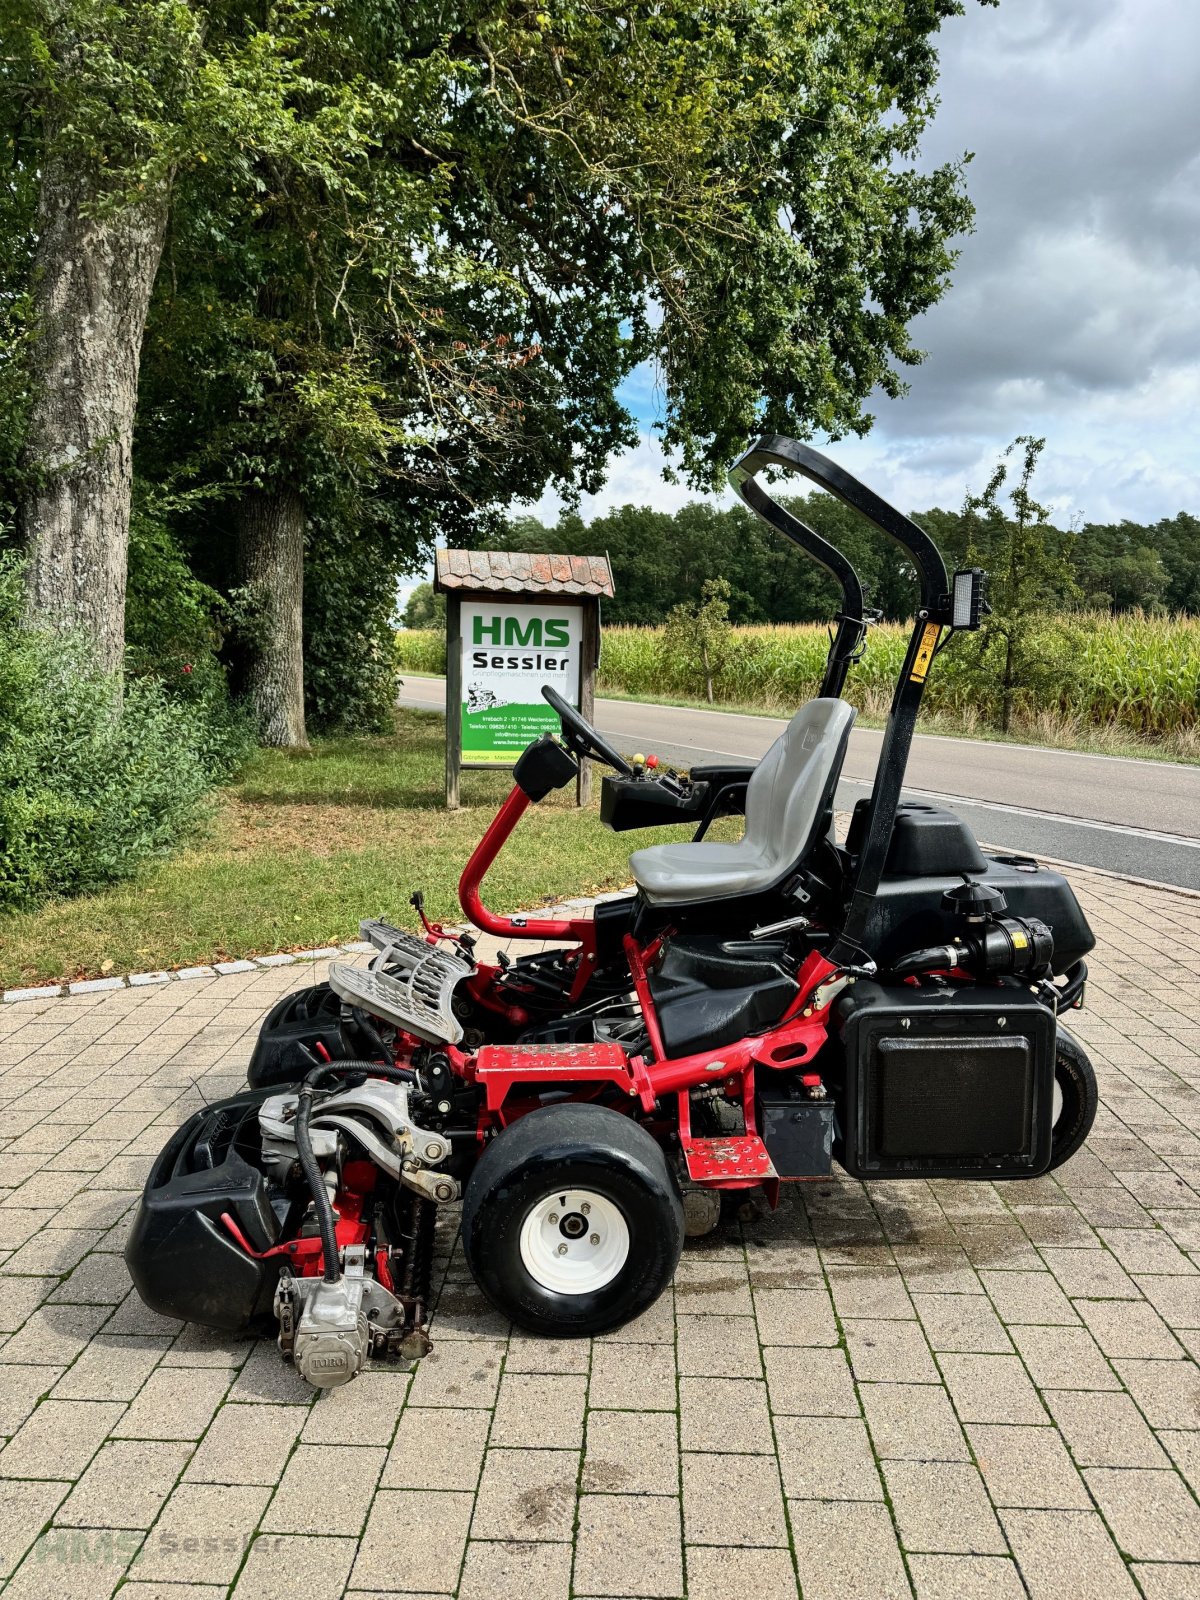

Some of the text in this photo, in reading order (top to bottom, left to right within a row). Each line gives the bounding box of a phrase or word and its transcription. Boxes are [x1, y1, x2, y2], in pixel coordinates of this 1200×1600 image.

[473, 616, 570, 647] HMS
[473, 652, 569, 670] Sessler
[312, 1358, 344, 1369] TORO
